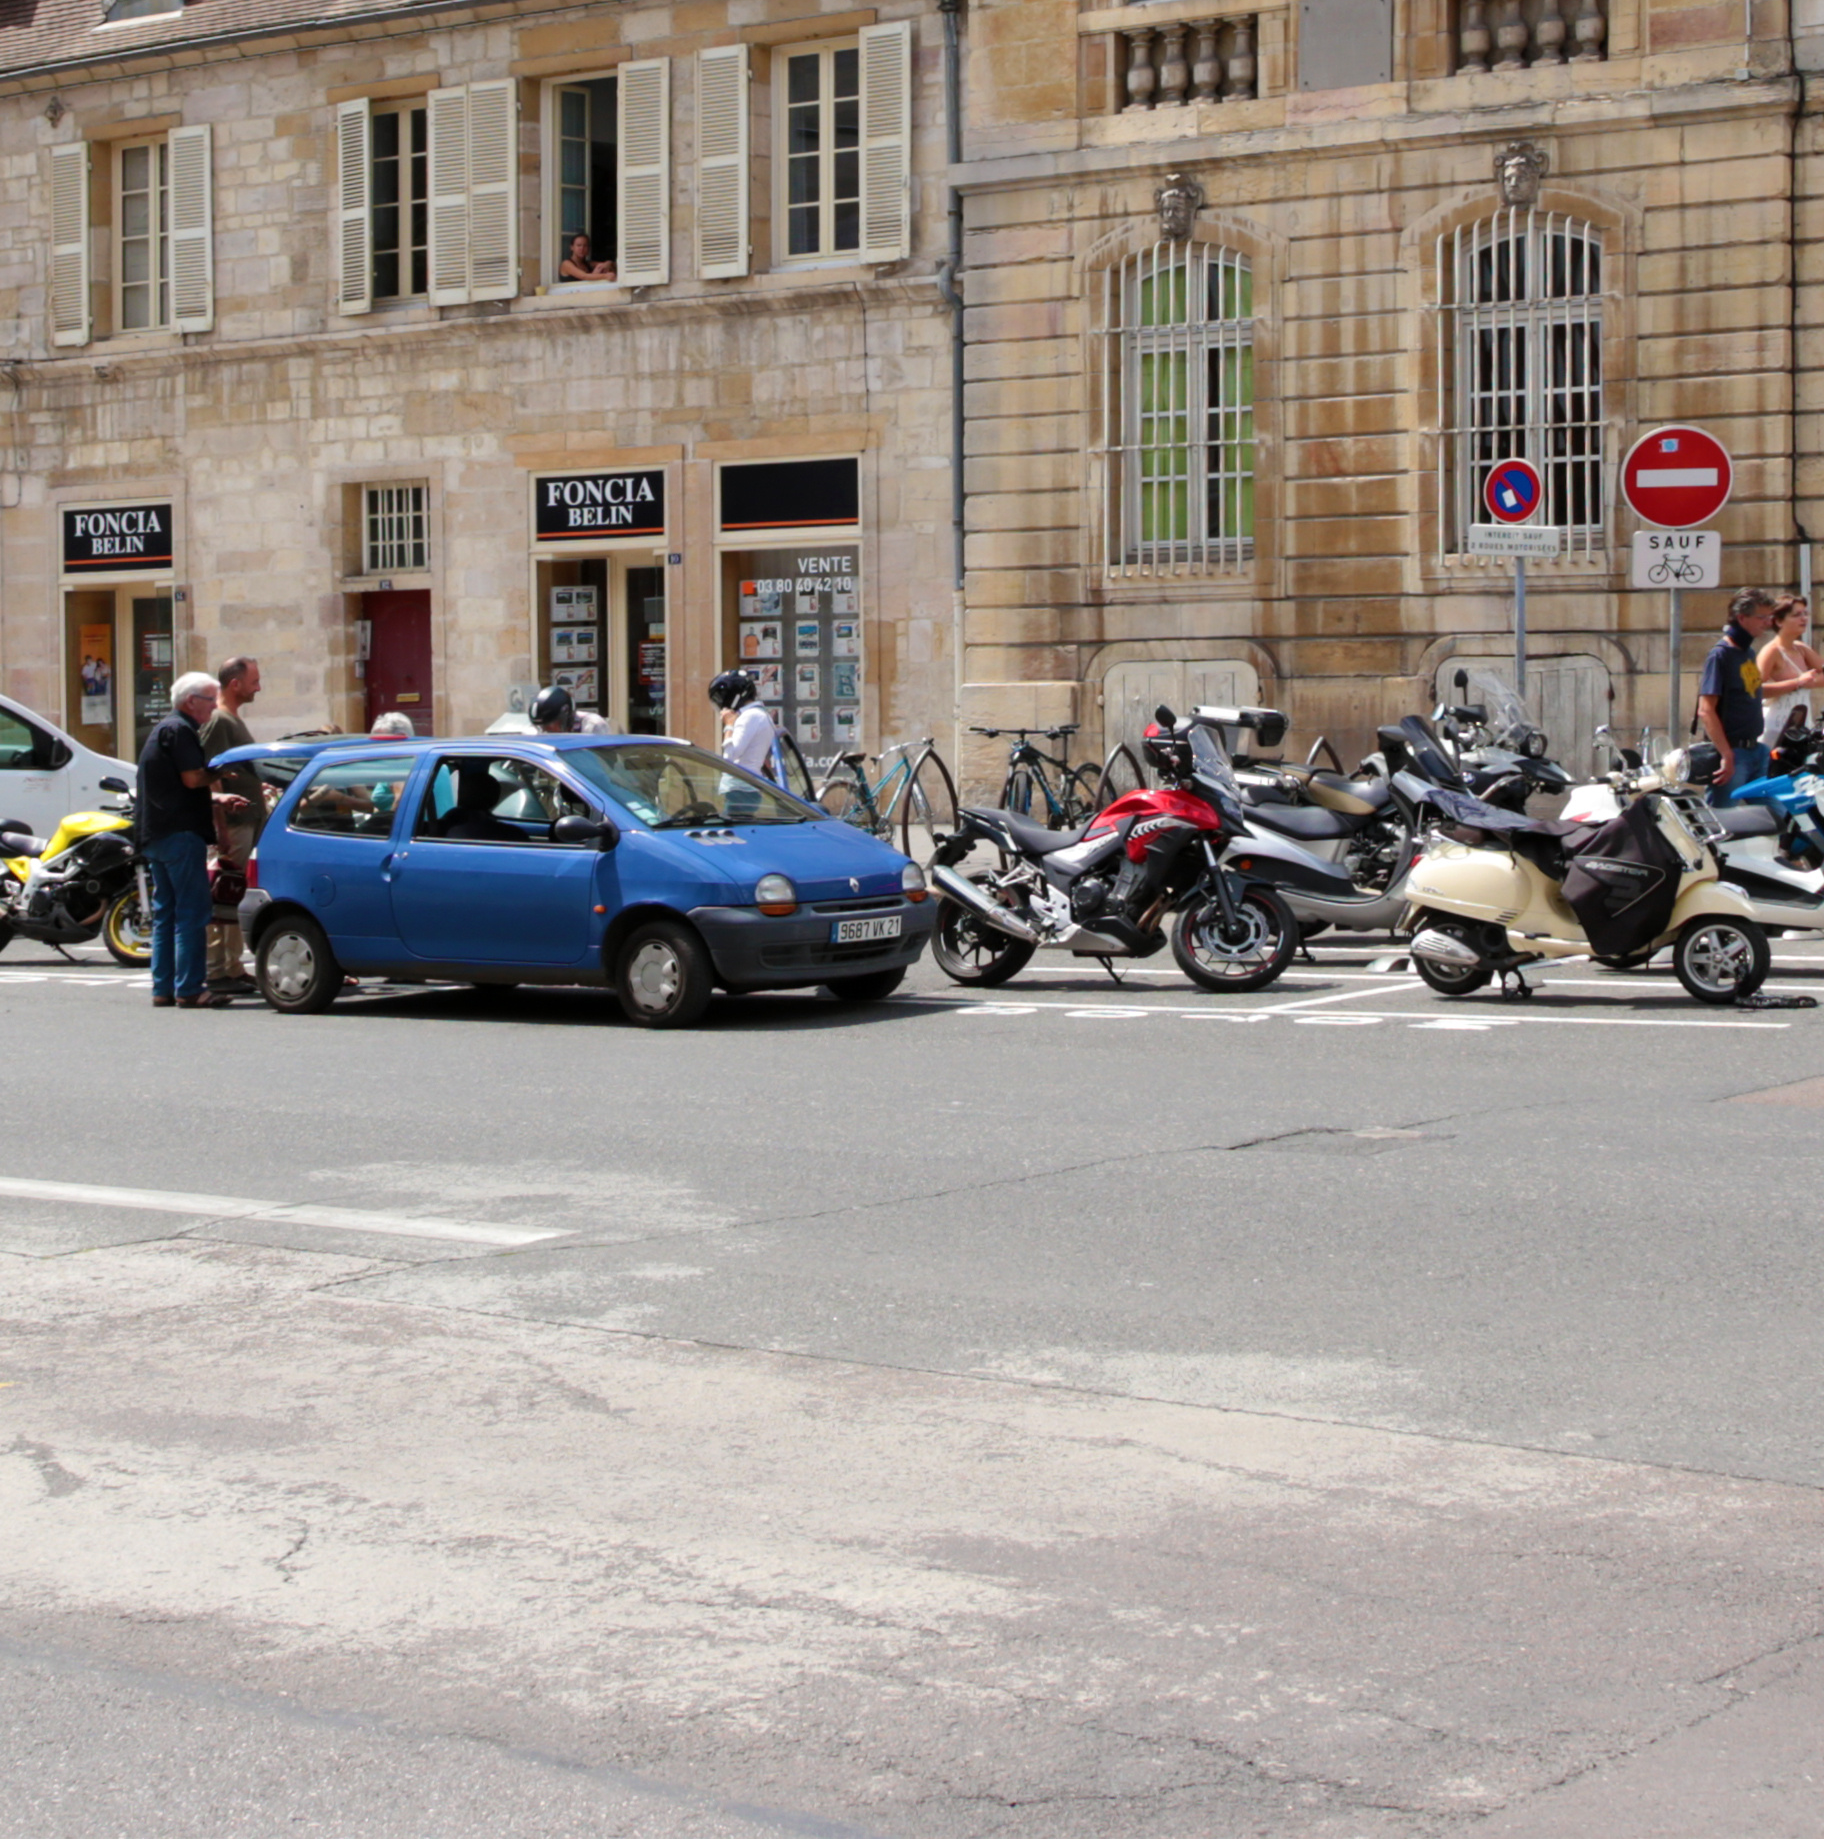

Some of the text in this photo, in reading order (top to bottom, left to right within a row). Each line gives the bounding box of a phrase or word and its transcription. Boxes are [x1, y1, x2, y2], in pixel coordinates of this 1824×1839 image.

[547, 477, 655, 507] FONCIA
[74, 510, 162, 537] FONCIA
[568, 505, 633, 527] BELIN
[92, 535, 145, 555] BELIN
[1523, 533, 1543, 541] SAUF
[1649, 535, 1706, 550] SAUF
[797, 556, 852, 574] VENTE
[756, 576, 852, 594] 03 80 40 42 10
[840, 918, 899, 940] 9687 VK 21
